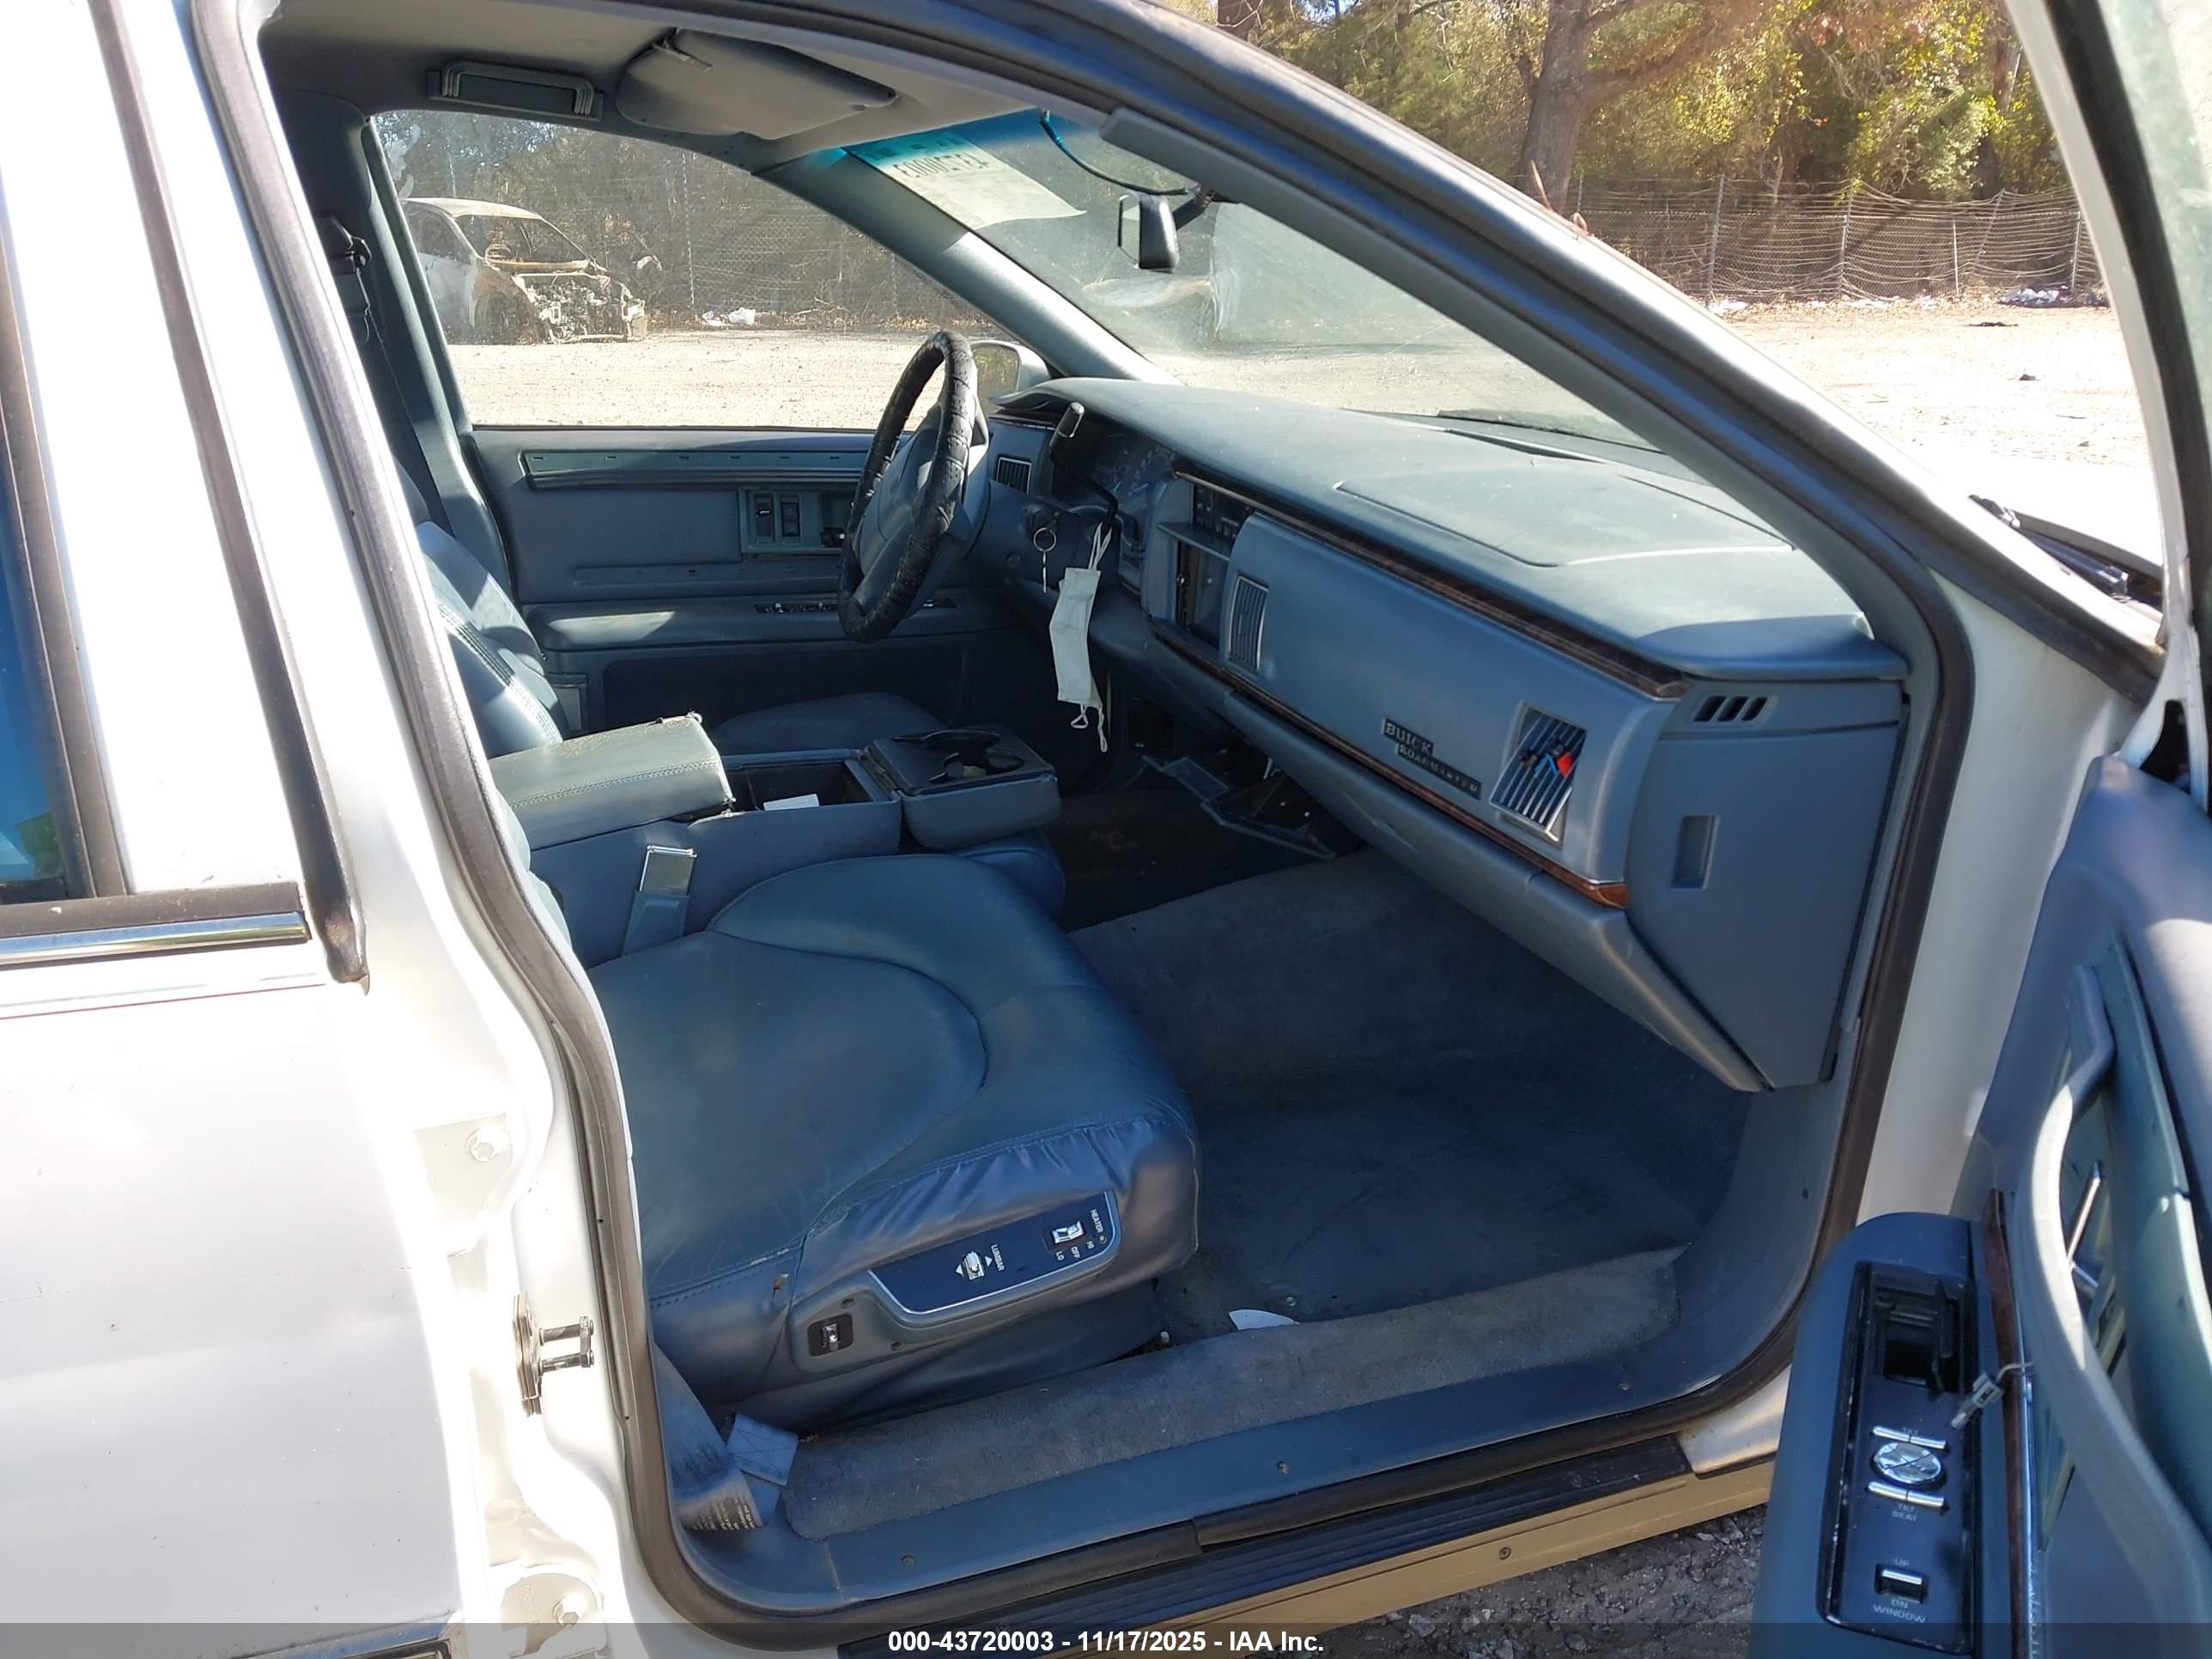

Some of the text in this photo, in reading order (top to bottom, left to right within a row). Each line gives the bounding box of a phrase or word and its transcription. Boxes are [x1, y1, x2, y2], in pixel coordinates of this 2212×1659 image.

[1385, 721, 1431, 757] BUICK
[1090, 1208, 1104, 1235] HEATER
[990, 1243, 1006, 1272] LUMBAR
[1055, 1250, 1066, 1261] LO
[1071, 1245, 1080, 1260] OFF
[1891, 1511, 1917, 1522] SEAT
[1893, 1559, 1911, 1567] UP
[1873, 1603, 1927, 1624] WINDOW
